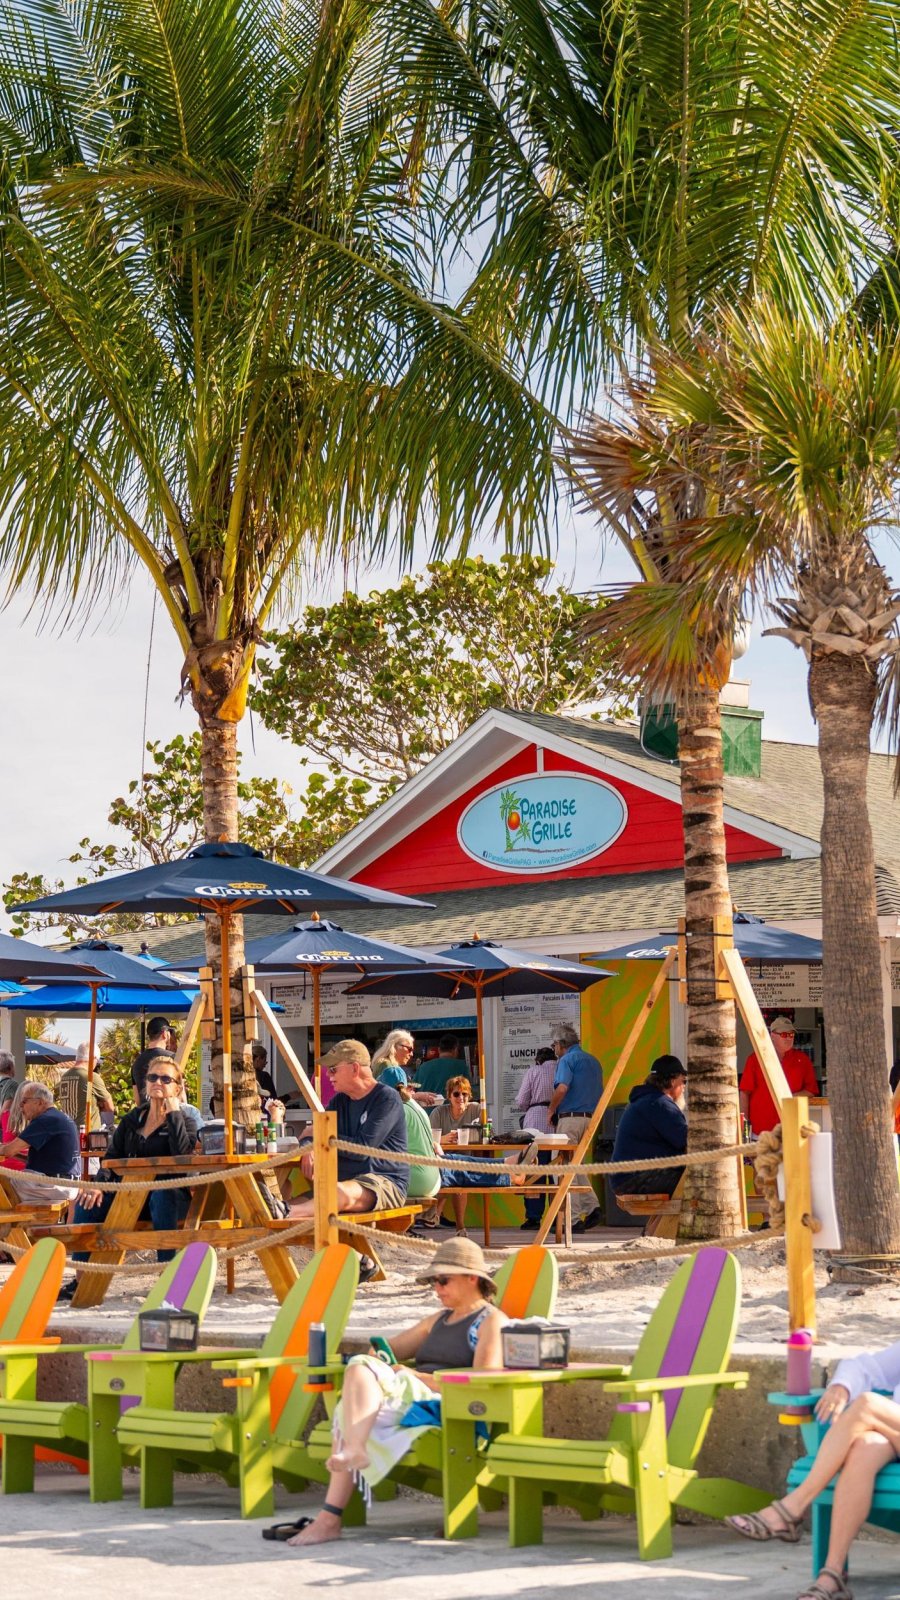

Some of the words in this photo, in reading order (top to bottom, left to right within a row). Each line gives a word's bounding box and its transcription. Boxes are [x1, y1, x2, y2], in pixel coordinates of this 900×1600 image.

[520, 798, 577, 822] PARADISE
[532, 821, 573, 845] GRILLE
[194, 885, 312, 897] Corona
[296, 952, 384, 962] Corona
[524, 1005, 535, 1013] Gravy
[509, 1028, 517, 1036] Egg
[510, 1049, 536, 1058] LUNCH
